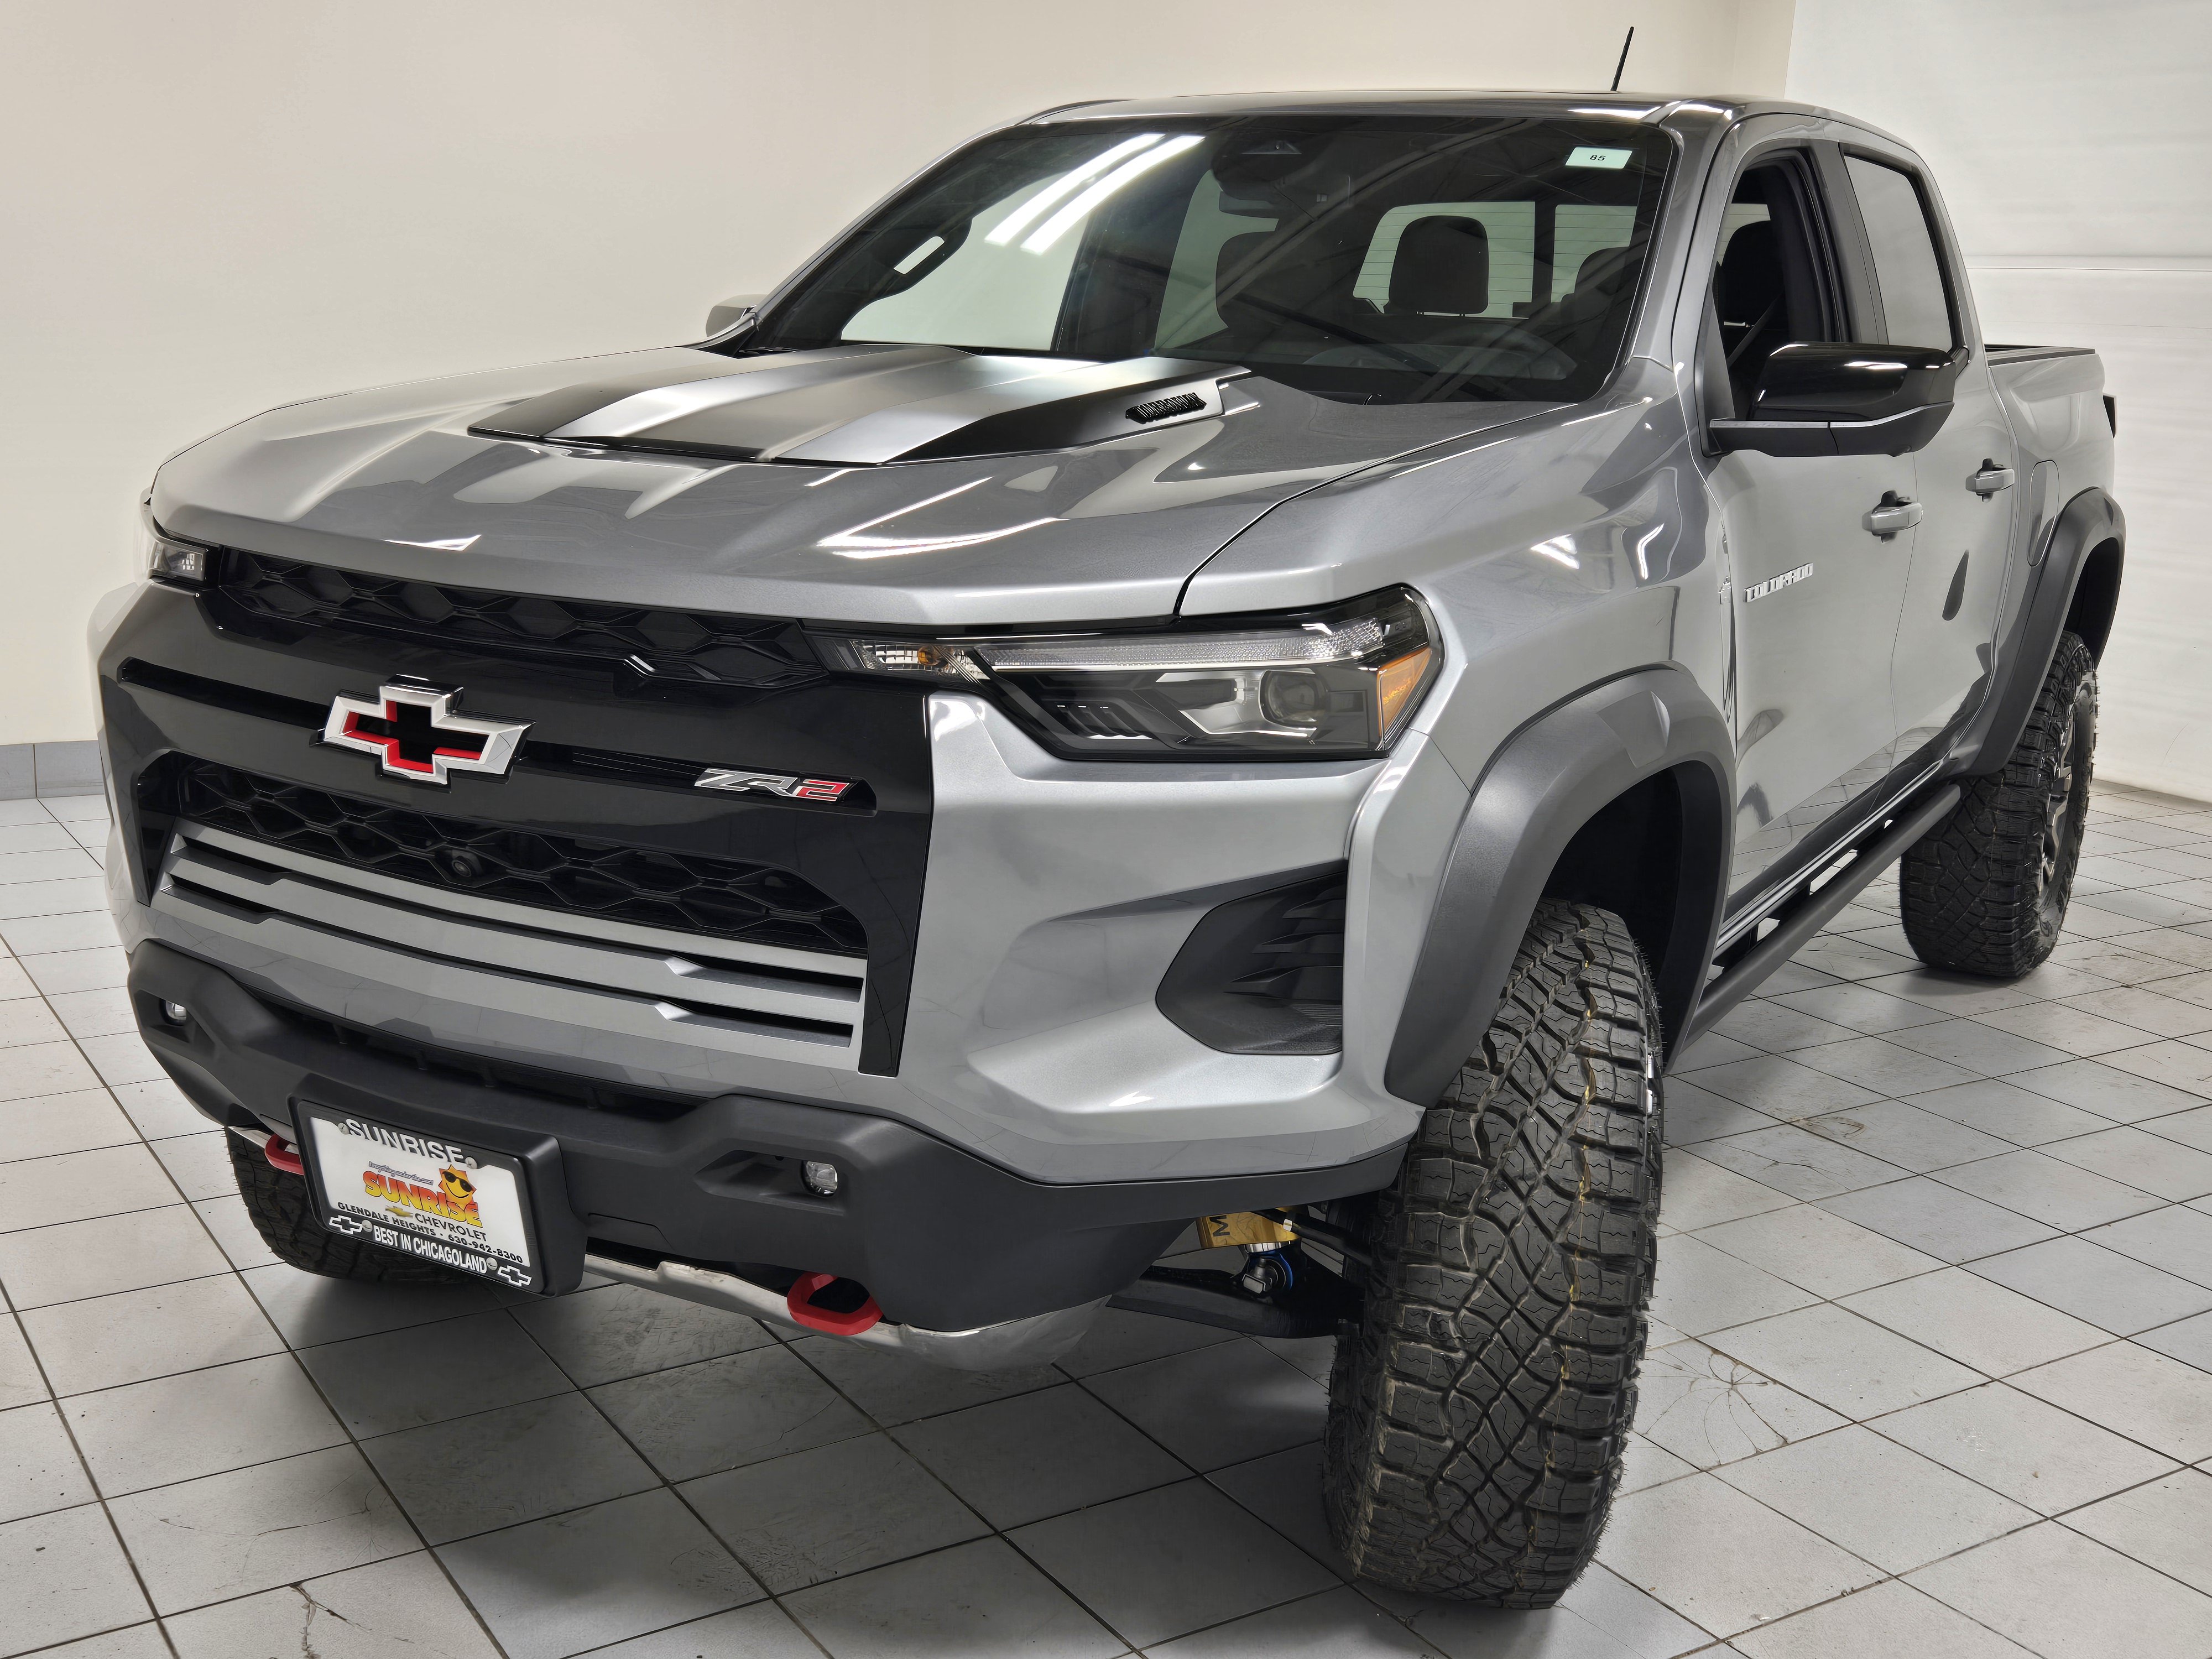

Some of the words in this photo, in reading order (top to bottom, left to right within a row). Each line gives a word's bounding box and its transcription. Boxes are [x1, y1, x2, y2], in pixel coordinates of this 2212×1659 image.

[694, 768, 849, 802] ZR2
[346, 1119, 467, 1165] SUNRISE
[363, 1170, 483, 1228] SUNRISE
[337, 1202, 389, 1222] GLENDALE
[392, 1217, 436, 1236] HEIGHTS
[448, 1234, 523, 1264] 630-942-8300
[374, 1225, 398, 1246] BEST
[400, 1233, 412, 1251] IN
[413, 1237, 487, 1274] CHICAGOLAND
[415, 1213, 487, 1241] CHEVROLET
